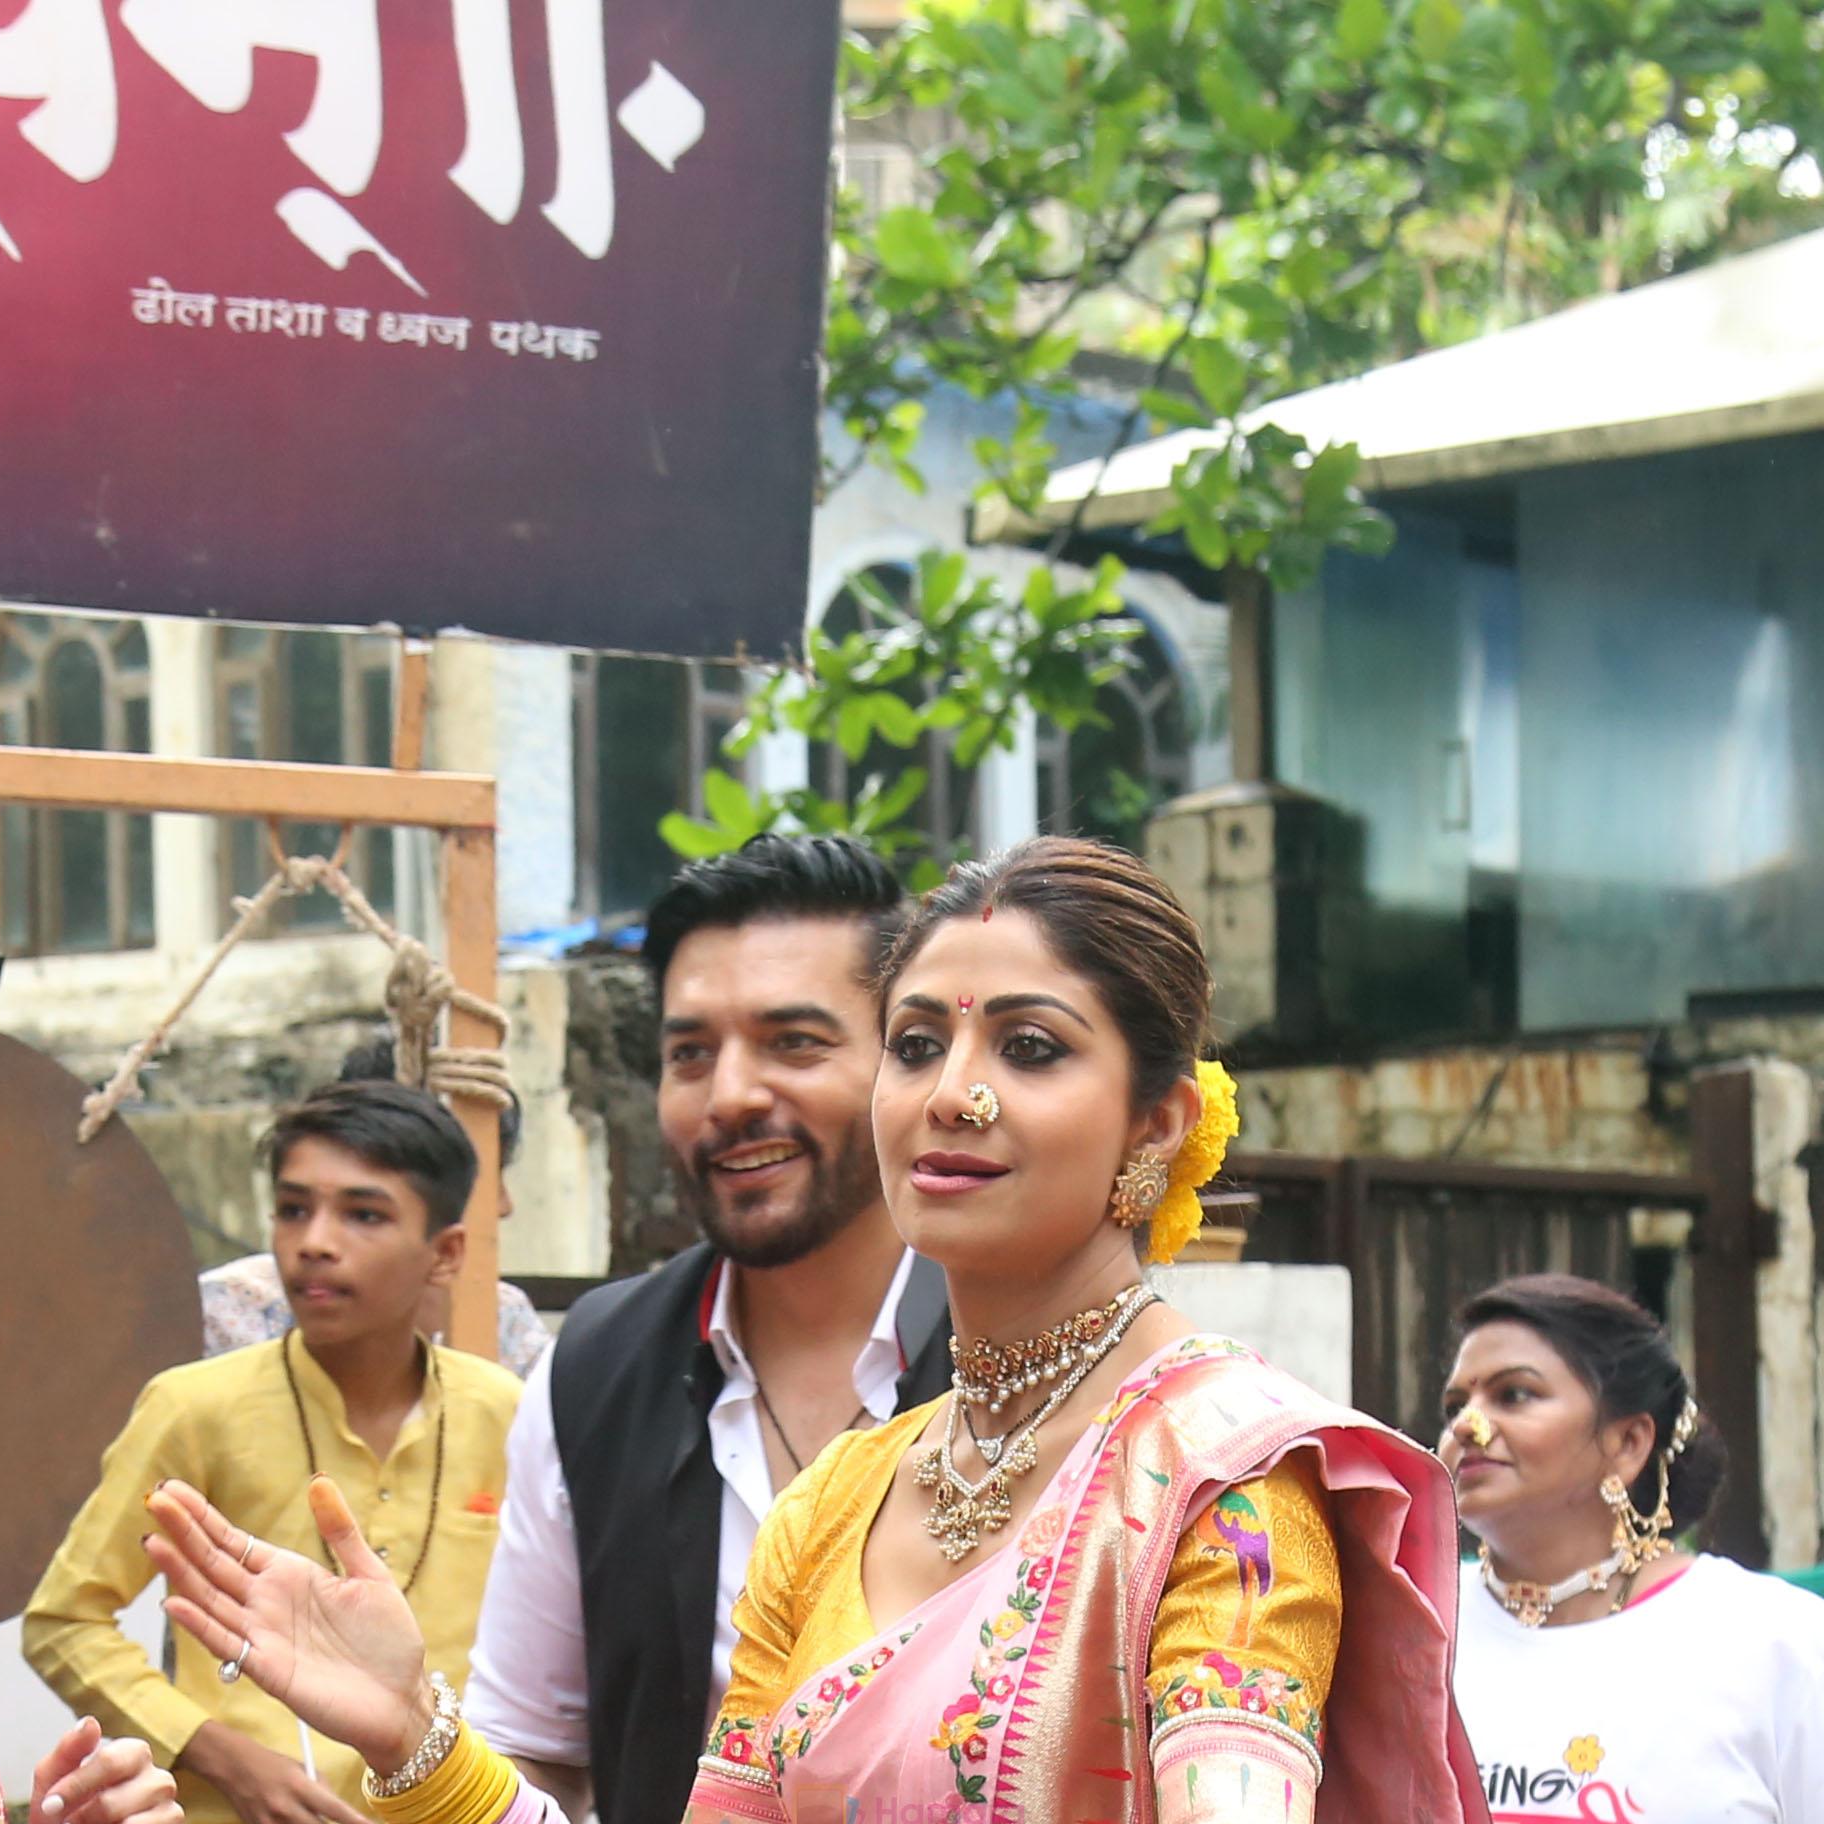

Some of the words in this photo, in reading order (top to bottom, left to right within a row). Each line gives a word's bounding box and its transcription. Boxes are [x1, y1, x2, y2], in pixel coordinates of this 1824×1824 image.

[130, 276, 217, 328] ढोल
[225, 295, 328, 339] ताशा
[379, 311, 472, 351] ध्वज
[489, 319, 601, 362] पथक
